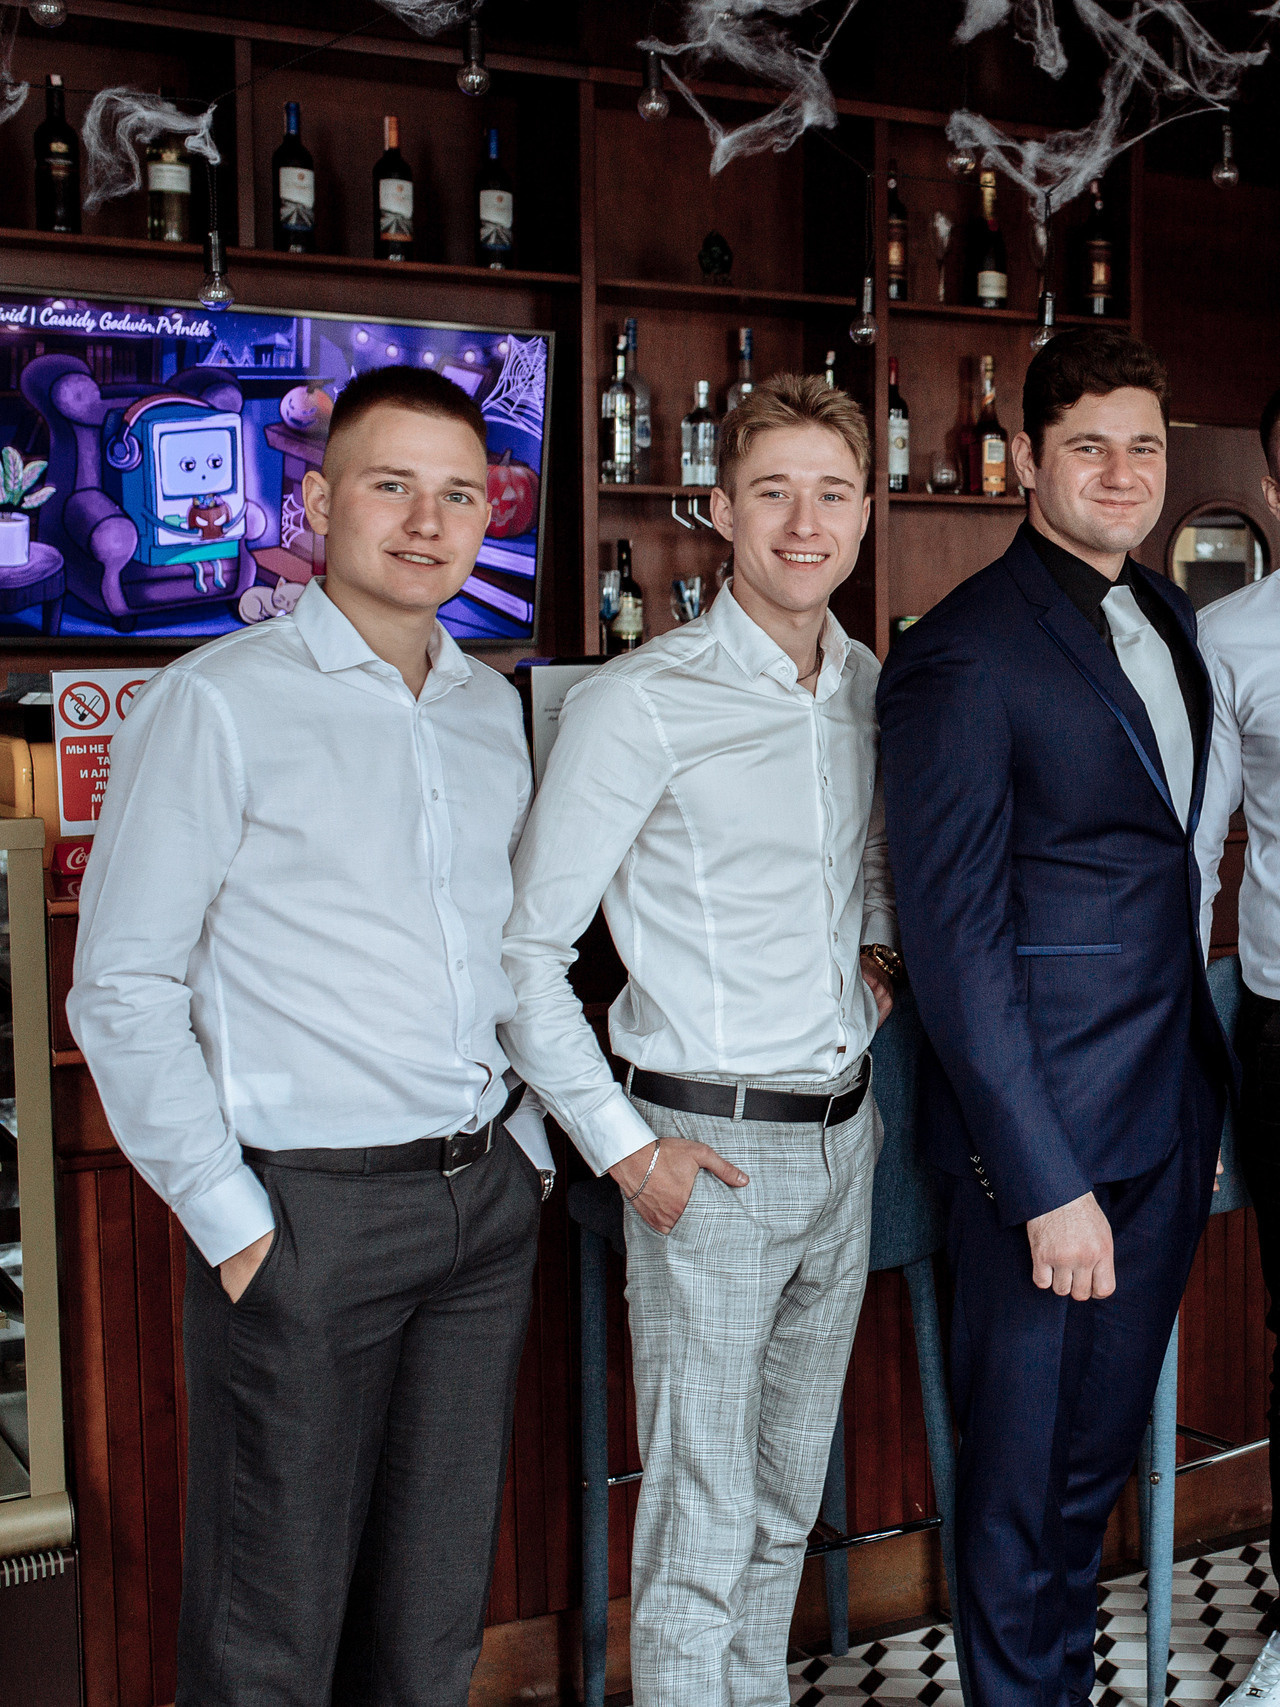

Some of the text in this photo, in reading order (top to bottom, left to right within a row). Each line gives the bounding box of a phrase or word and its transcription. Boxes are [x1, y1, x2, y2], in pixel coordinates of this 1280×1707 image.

[40, 307, 96, 333] Cassidy
[65, 745, 87, 755] МЫ
[89, 744, 105, 753] НЕ
[96, 756, 111, 765] ТА
[80, 768, 110, 779] И АЛ
